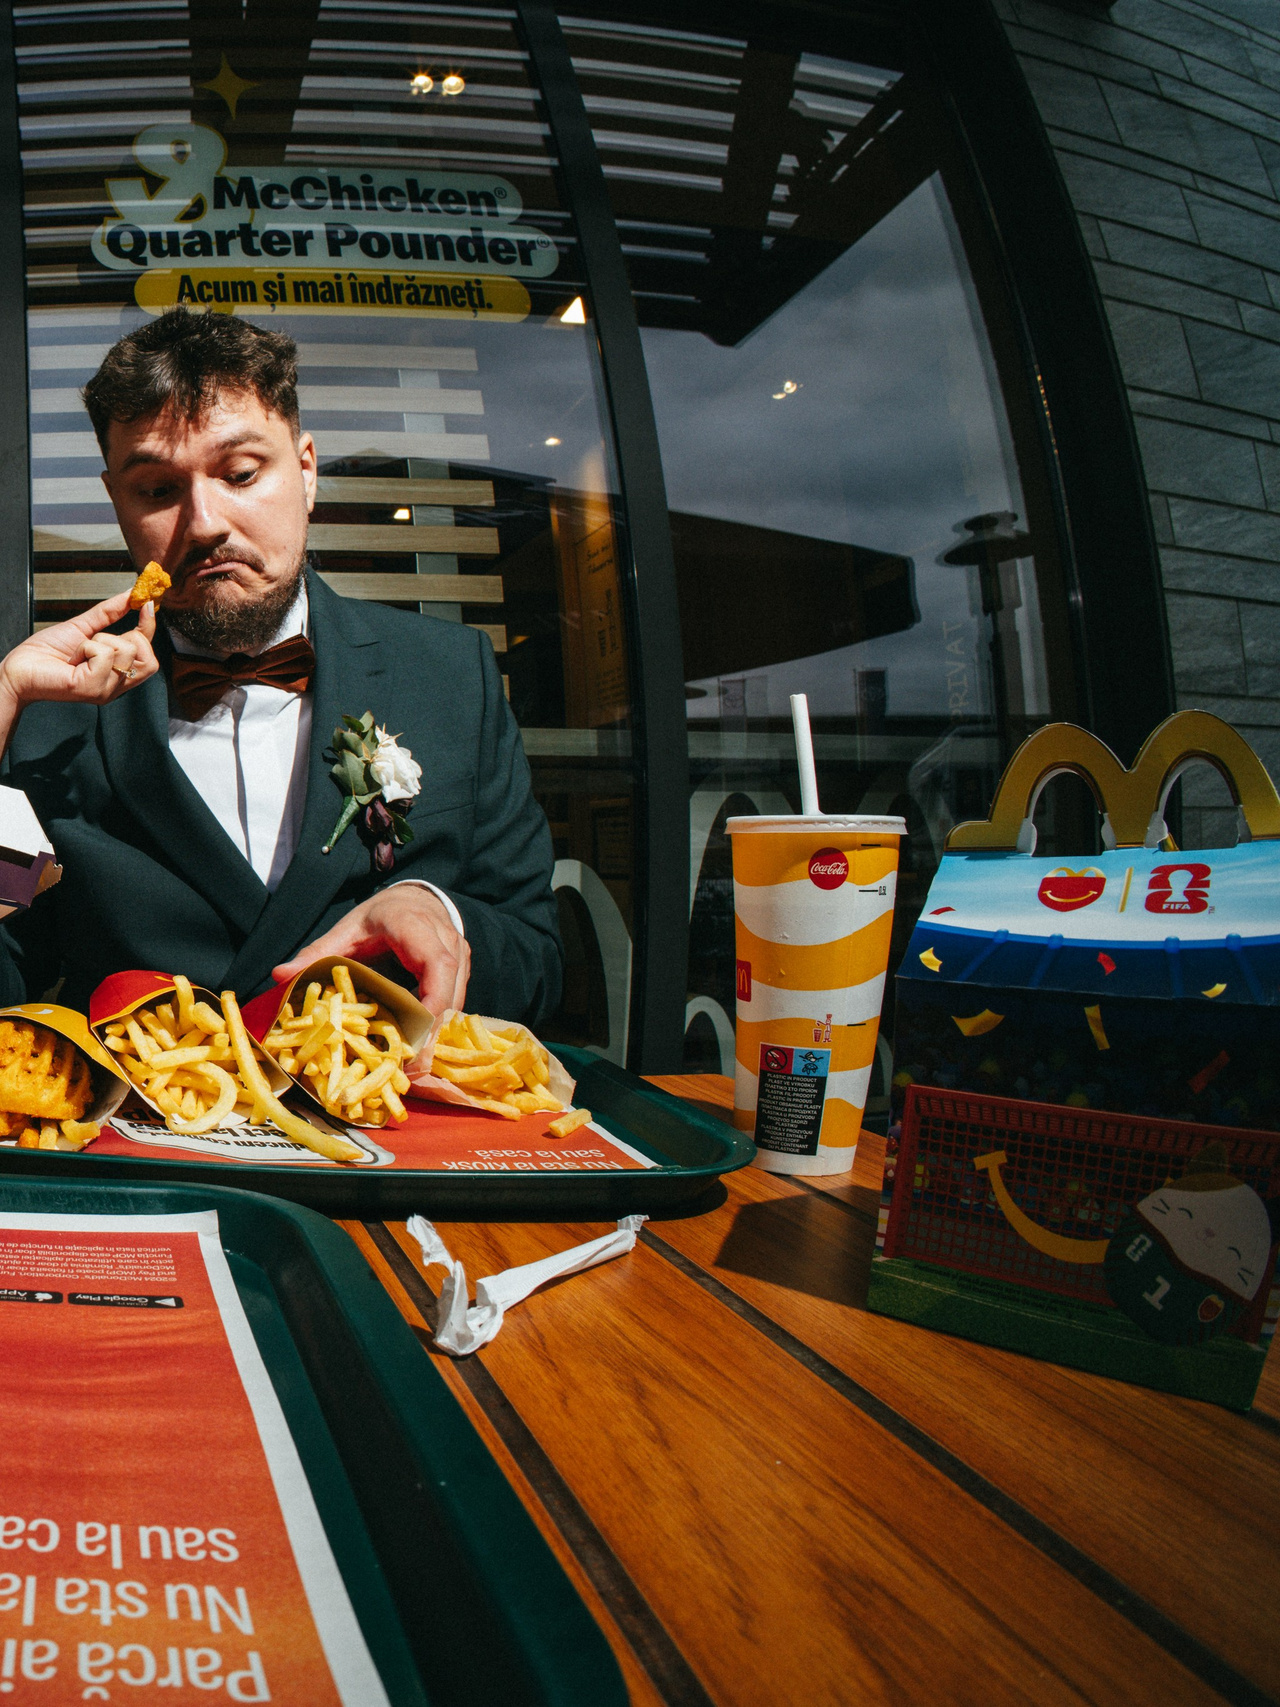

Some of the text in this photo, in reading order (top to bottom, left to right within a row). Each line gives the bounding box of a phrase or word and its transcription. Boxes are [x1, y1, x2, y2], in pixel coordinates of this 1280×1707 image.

[106, 222, 314, 266] Quarter
[177, 272, 493, 318] Acum și mai îndrăzneți.
[1162, 903, 1191, 911] FIFA
[468, 1149, 606, 1160] sau la casă.
[539, 1160, 580, 1170] sta
[585, 1160, 623, 1170] Nu
[75, 1293, 148, 1303] Google Play
[74, 1522, 122, 1571] la
[137, 1523, 241, 1566] sau
[53, 1576, 148, 1629] sta
[164, 1582, 255, 1638] Nu
[75, 1641, 271, 1703] Parcă
